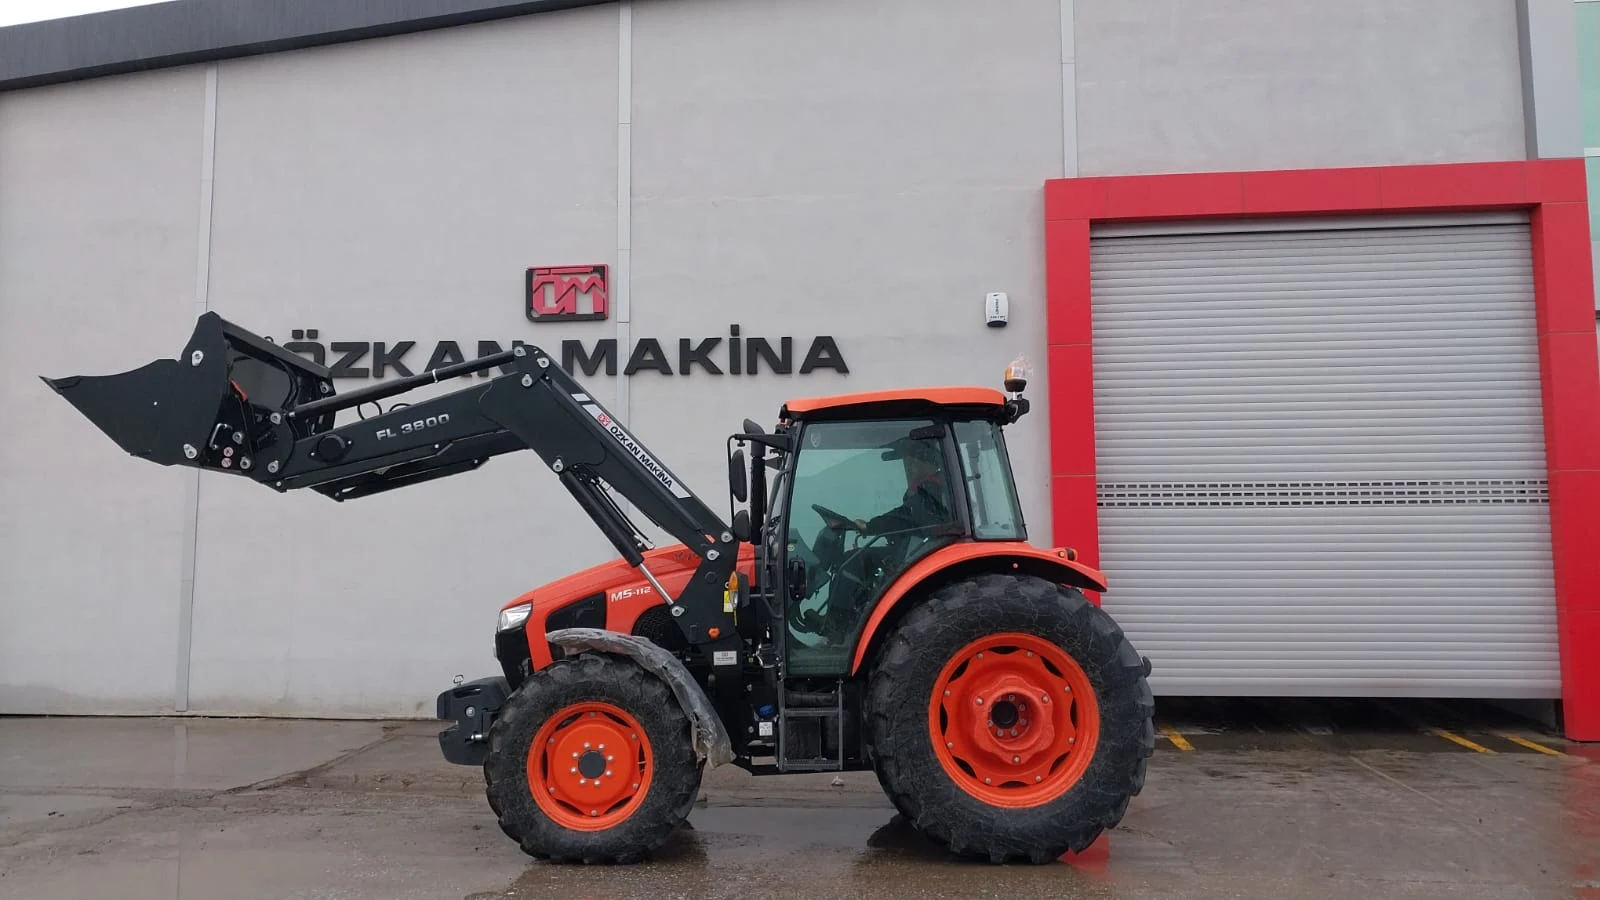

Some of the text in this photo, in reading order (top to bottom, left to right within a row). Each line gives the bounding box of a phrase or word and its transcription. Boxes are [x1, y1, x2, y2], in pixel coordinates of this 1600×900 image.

[562, 324, 850, 376] MAKİNA
[376, 413, 450, 440] FL 3800
